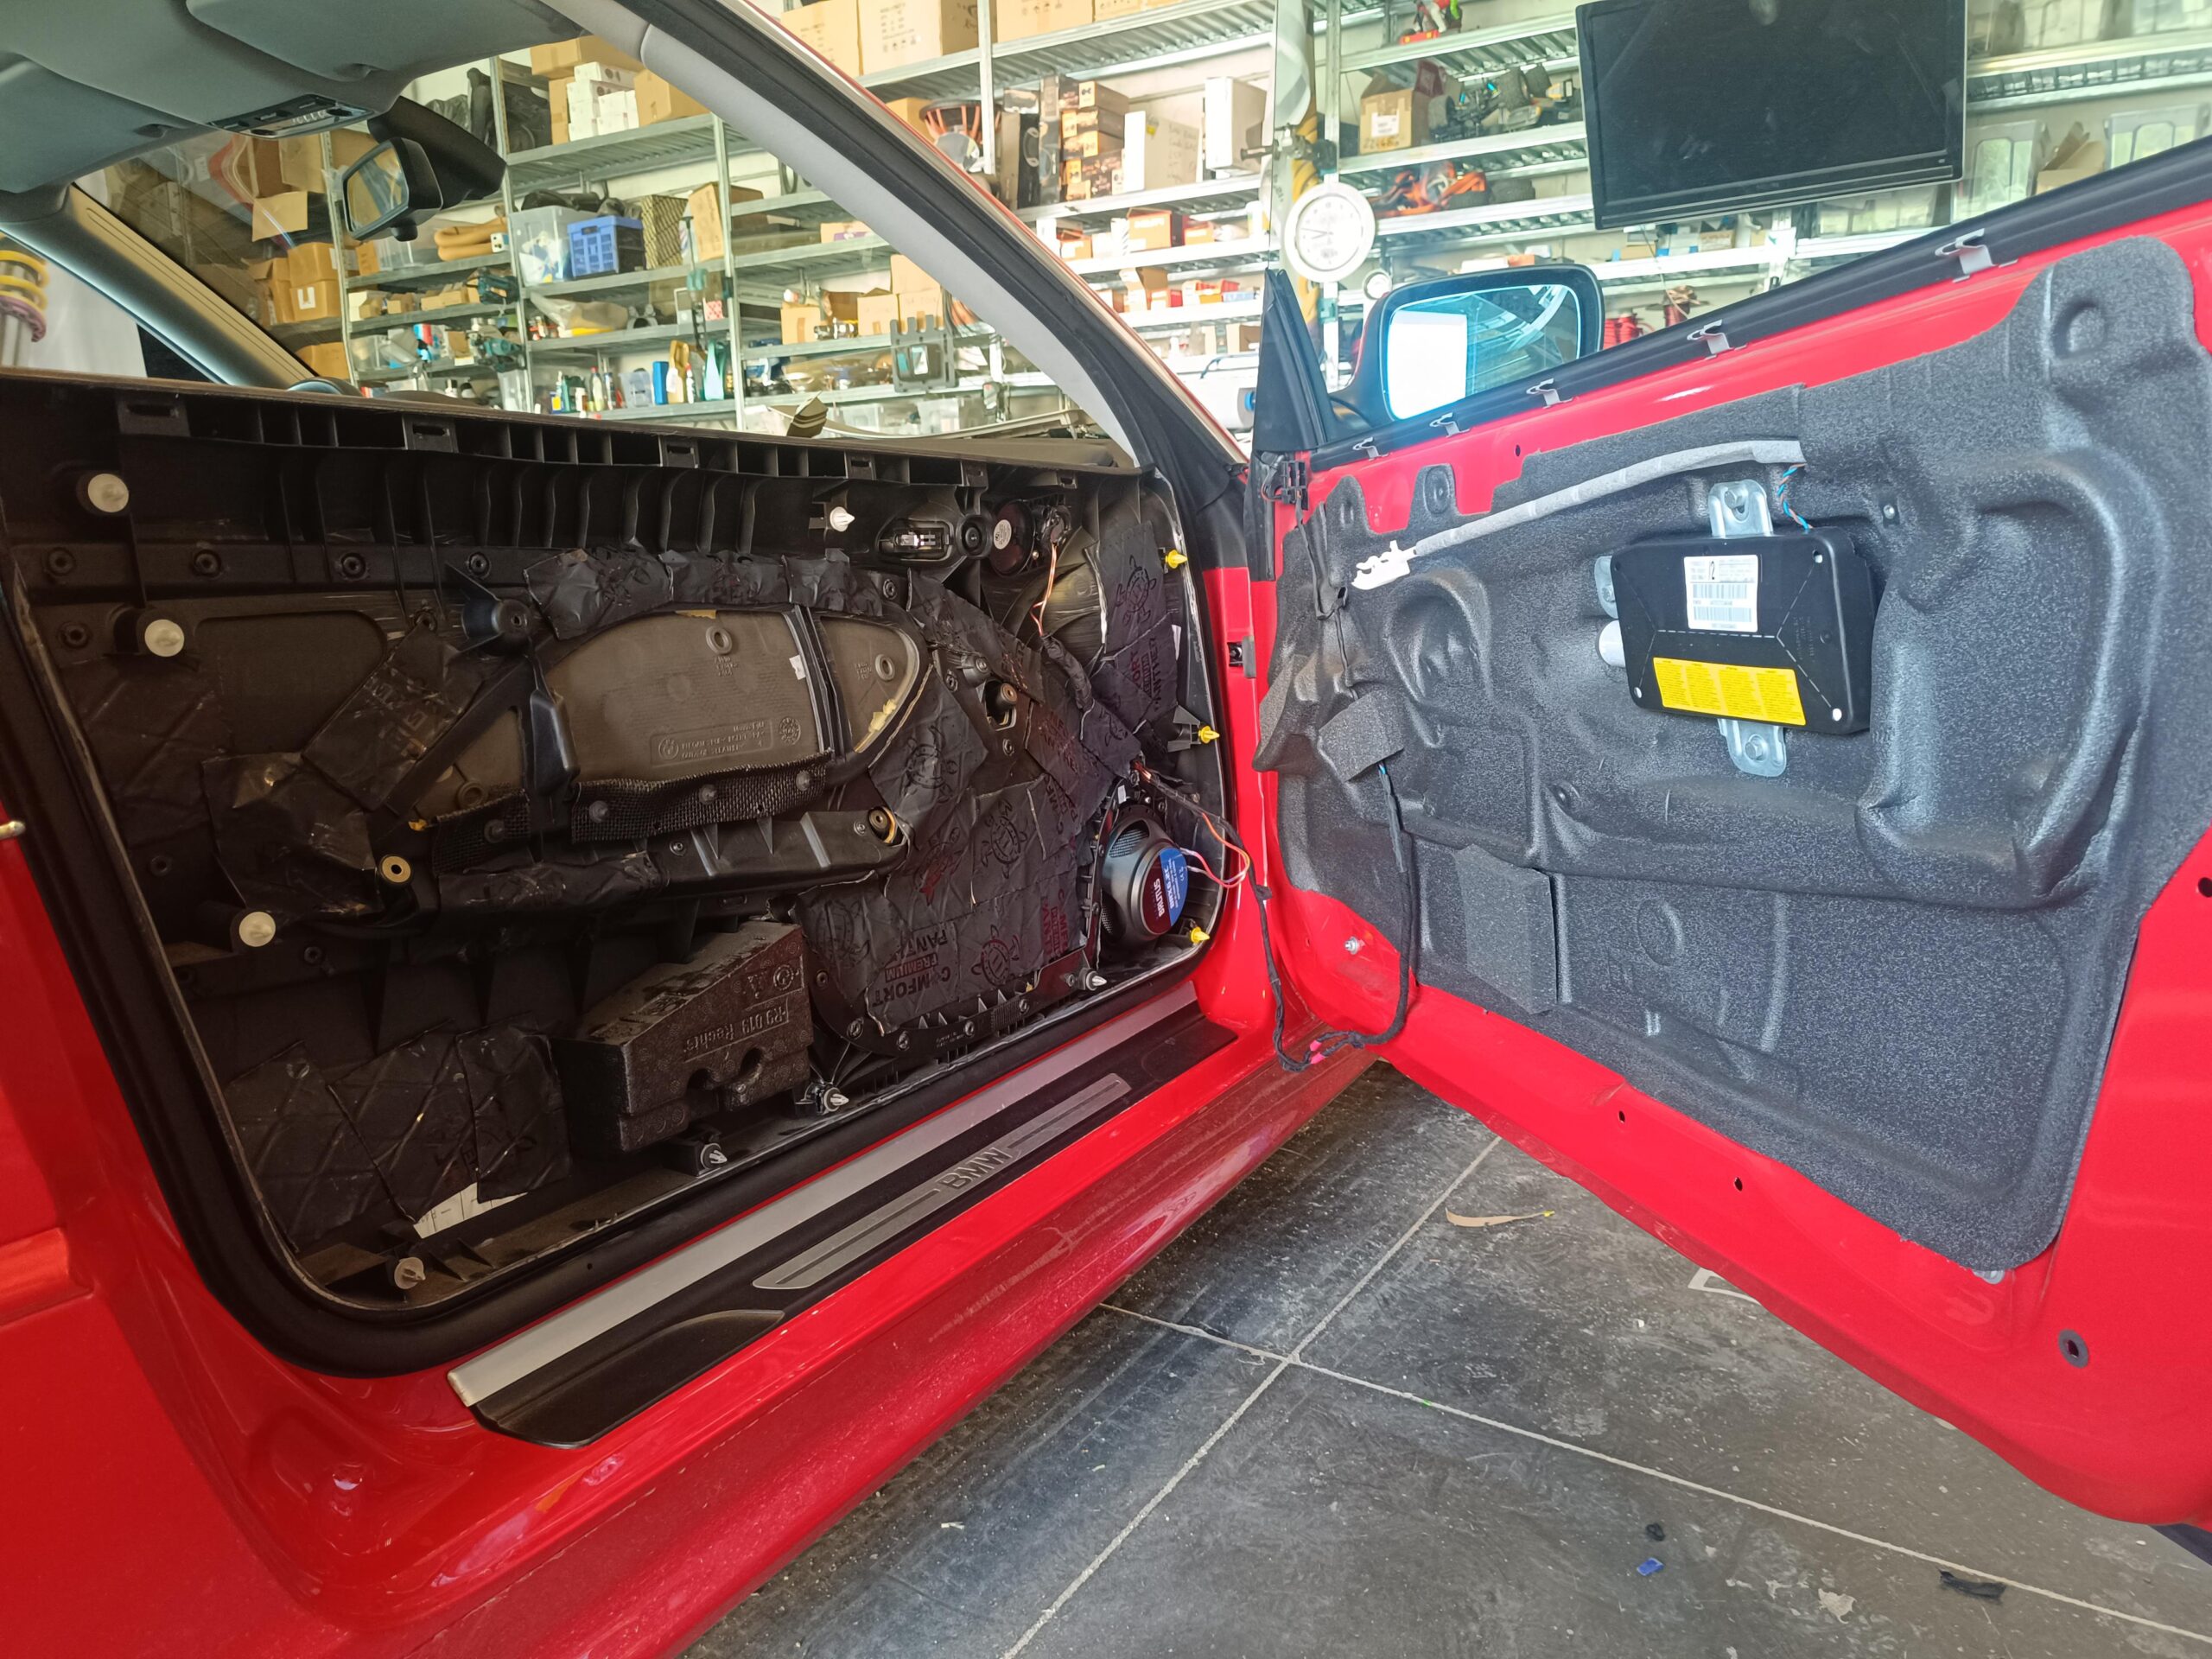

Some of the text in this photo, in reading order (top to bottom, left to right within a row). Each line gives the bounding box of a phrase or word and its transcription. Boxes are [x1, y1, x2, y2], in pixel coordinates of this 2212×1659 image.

[1154, 878, 1165, 918] BRUTUS
[885, 953, 938, 982] PREMIUM
[935, 1147, 1013, 1189] BMW
